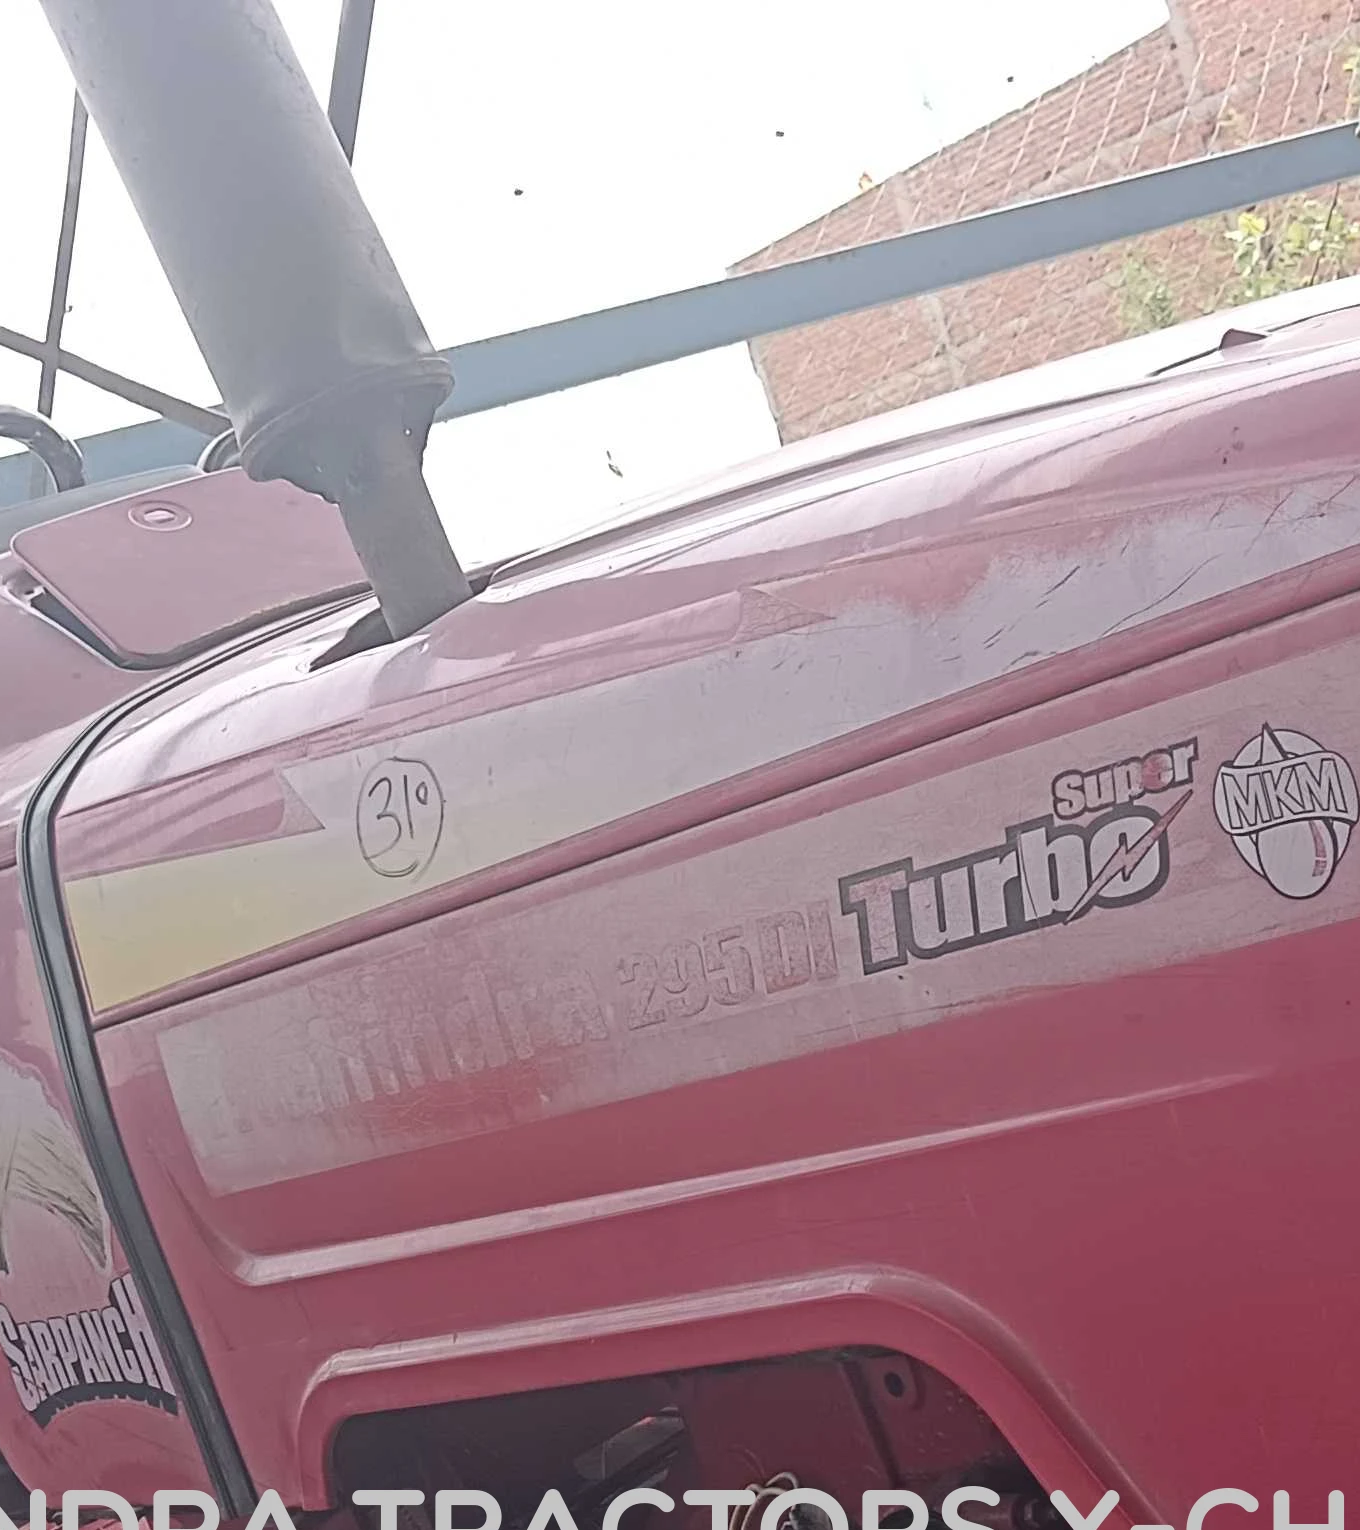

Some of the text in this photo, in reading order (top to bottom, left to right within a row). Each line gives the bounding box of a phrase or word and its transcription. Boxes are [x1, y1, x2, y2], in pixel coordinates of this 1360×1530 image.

[1051, 735, 1198, 819] Super
[1222, 757, 1349, 831] MKM
[838, 804, 1172, 976] Turbo
